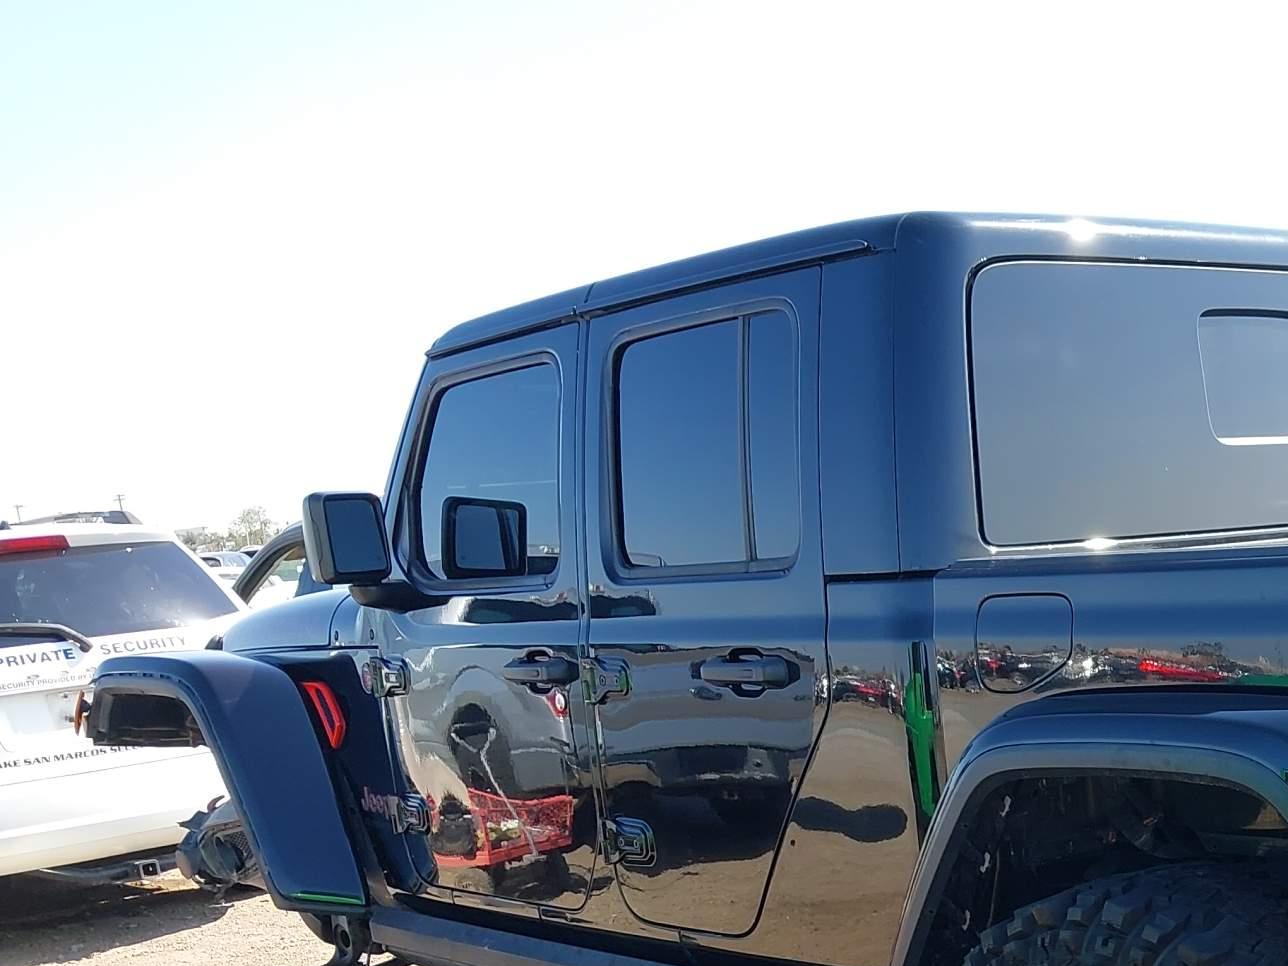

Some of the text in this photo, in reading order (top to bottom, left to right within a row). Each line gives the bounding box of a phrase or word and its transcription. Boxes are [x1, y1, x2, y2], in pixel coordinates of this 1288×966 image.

[100, 636, 185, 655] SECURITY
[23, 755, 51, 766] SAN
[53, 748, 107, 762] MARCOS
